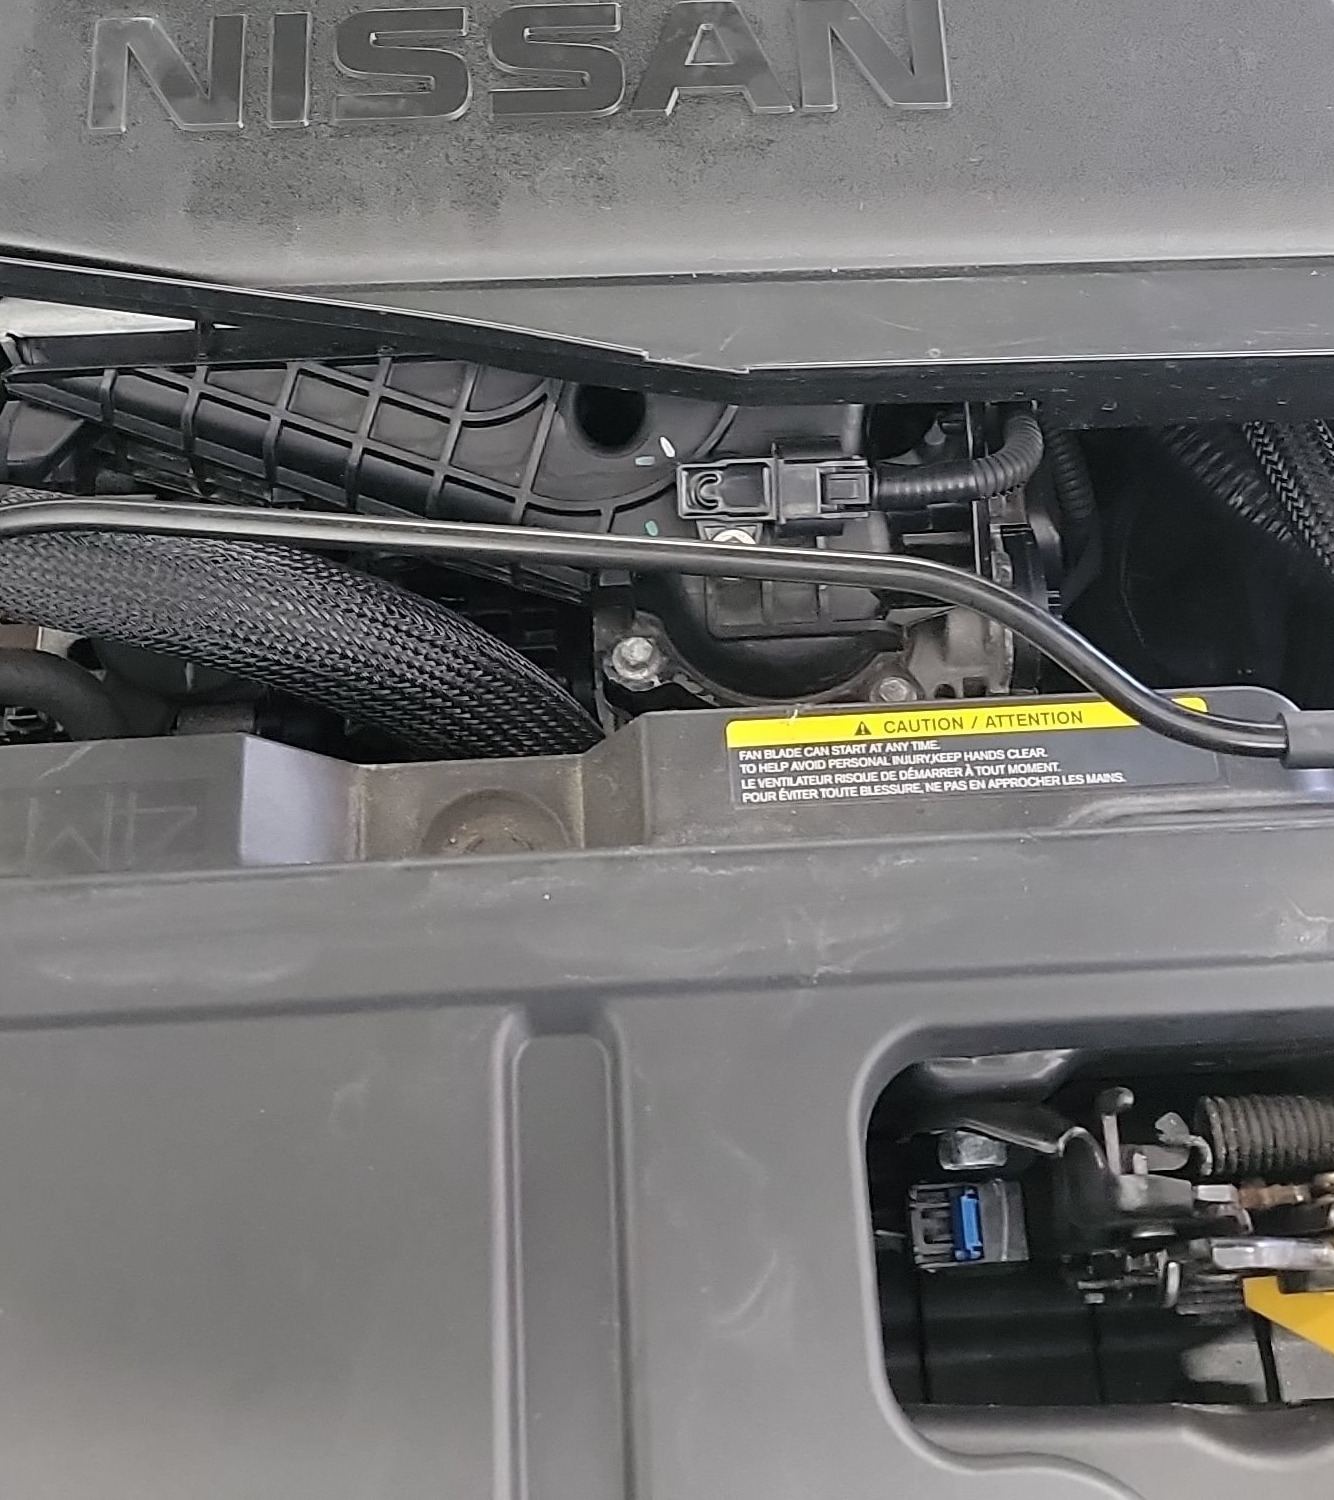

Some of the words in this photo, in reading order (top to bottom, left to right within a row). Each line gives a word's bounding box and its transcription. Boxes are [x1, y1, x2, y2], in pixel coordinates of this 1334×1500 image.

[883, 717, 964, 734] CAUTION
[985, 710, 1084, 729] ATTENTION
[739, 749, 763, 761] FAN
[764, 748, 802, 760] BLADE
[804, 746, 829, 758] CAN
[831, 744, 868, 756] START
[869, 743, 884, 754] AT
[885, 741, 910, 753] ANY
[911, 739, 940, 751] TIME.
[739, 763, 757, 774] TO
[759, 761, 789, 773] HELP
[790, 759, 826, 771] AVOID
[828, 756, 891, 770] PERSONAL
[964, 749, 1005, 761] HANDS
[1007, 747, 1048, 759] CLEAR.
[741, 778, 757, 789] LE
[757, 774, 832, 789] VENTILATEUR
[834, 771, 878, 784] RISQUE
[880, 770, 898, 781] DE
[899, 766, 964, 780] DÉMARRER
[964, 763, 975, 777] À
[976, 765, 1006, 777] TOUT
[1008, 761, 1062, 774] MOMENT.
[742, 791, 777, 803] POUR
[778, 787, 819, 802] ÉVITER
[820, 787, 858, 799] TOUTE
[860, 783, 924, 797] BLESSURE,
[925, 781, 942, 793] NE
[944, 779, 968, 791] PAS
[970, 779, 986, 791] EN
[987, 775, 1061, 790] APPROCHER
[1062, 774, 1085, 786] LES
[1086, 771, 1127, 784] MAINS.
